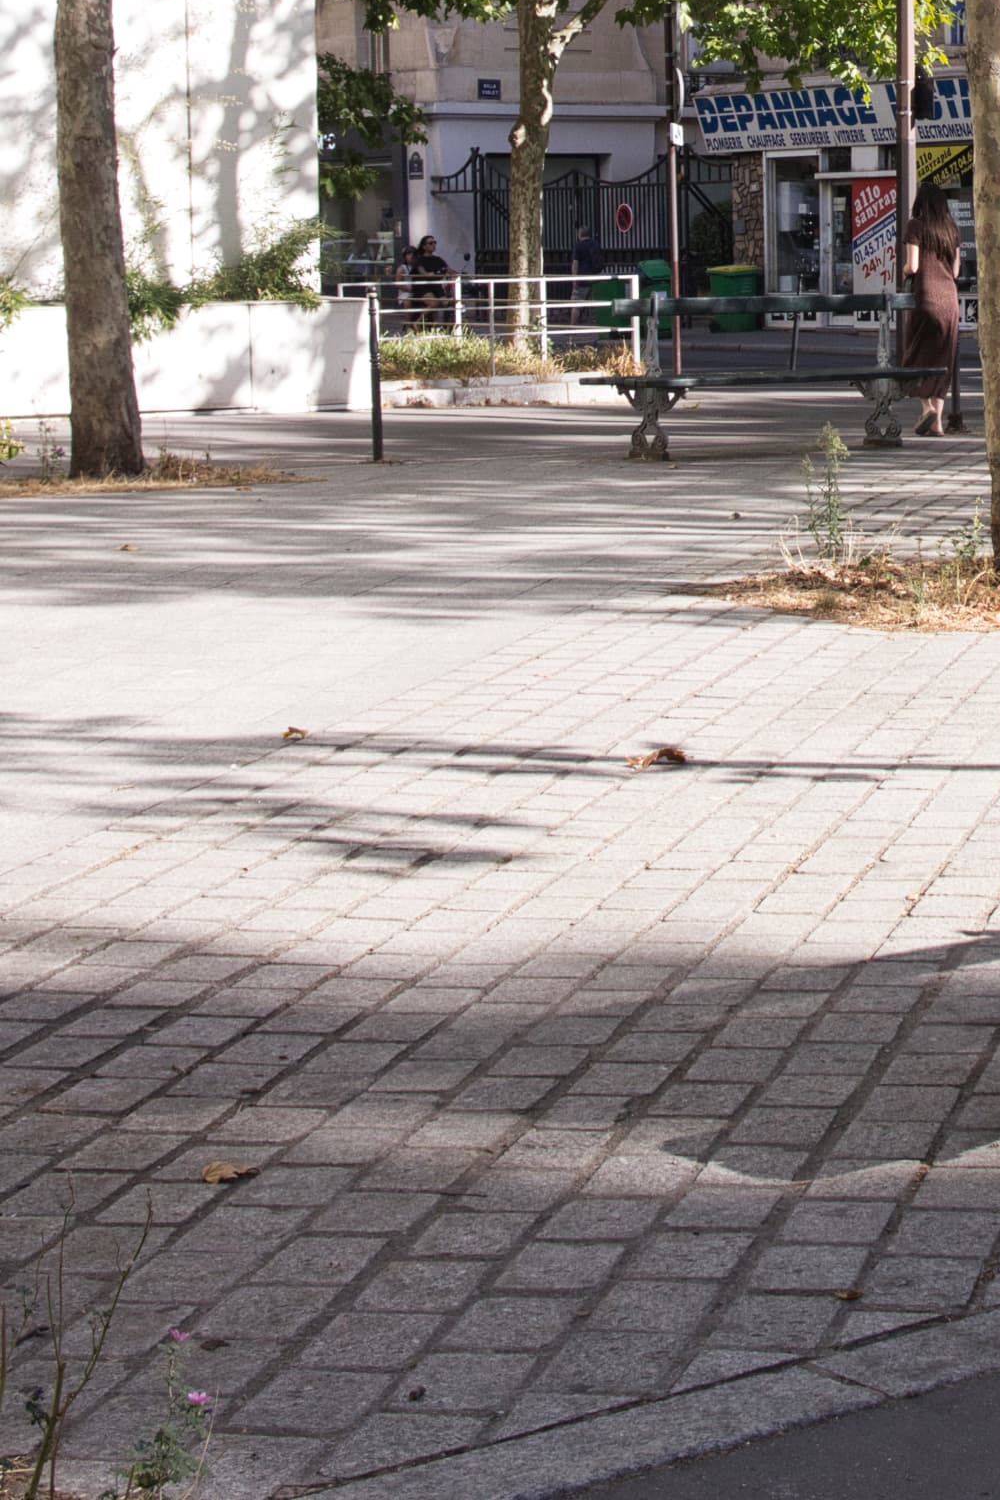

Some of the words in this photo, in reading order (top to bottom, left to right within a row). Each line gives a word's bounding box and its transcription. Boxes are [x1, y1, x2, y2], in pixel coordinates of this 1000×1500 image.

[694, 86, 878, 134] DEPANNAGE
[706, 135, 743, 151] PLOMBERIE
[747, 132, 787, 148] CHAUFFAGE
[790, 130, 831, 146] SERRURERIE
[836, 128, 866, 143] VITRERIE
[872, 126, 897, 142] ELECTR
[854, 185, 881, 213] allo
[855, 188, 897, 228] sanyrap
[854, 224, 897, 265] 01.45.77.04
[861, 246, 897, 280] 24h/2
